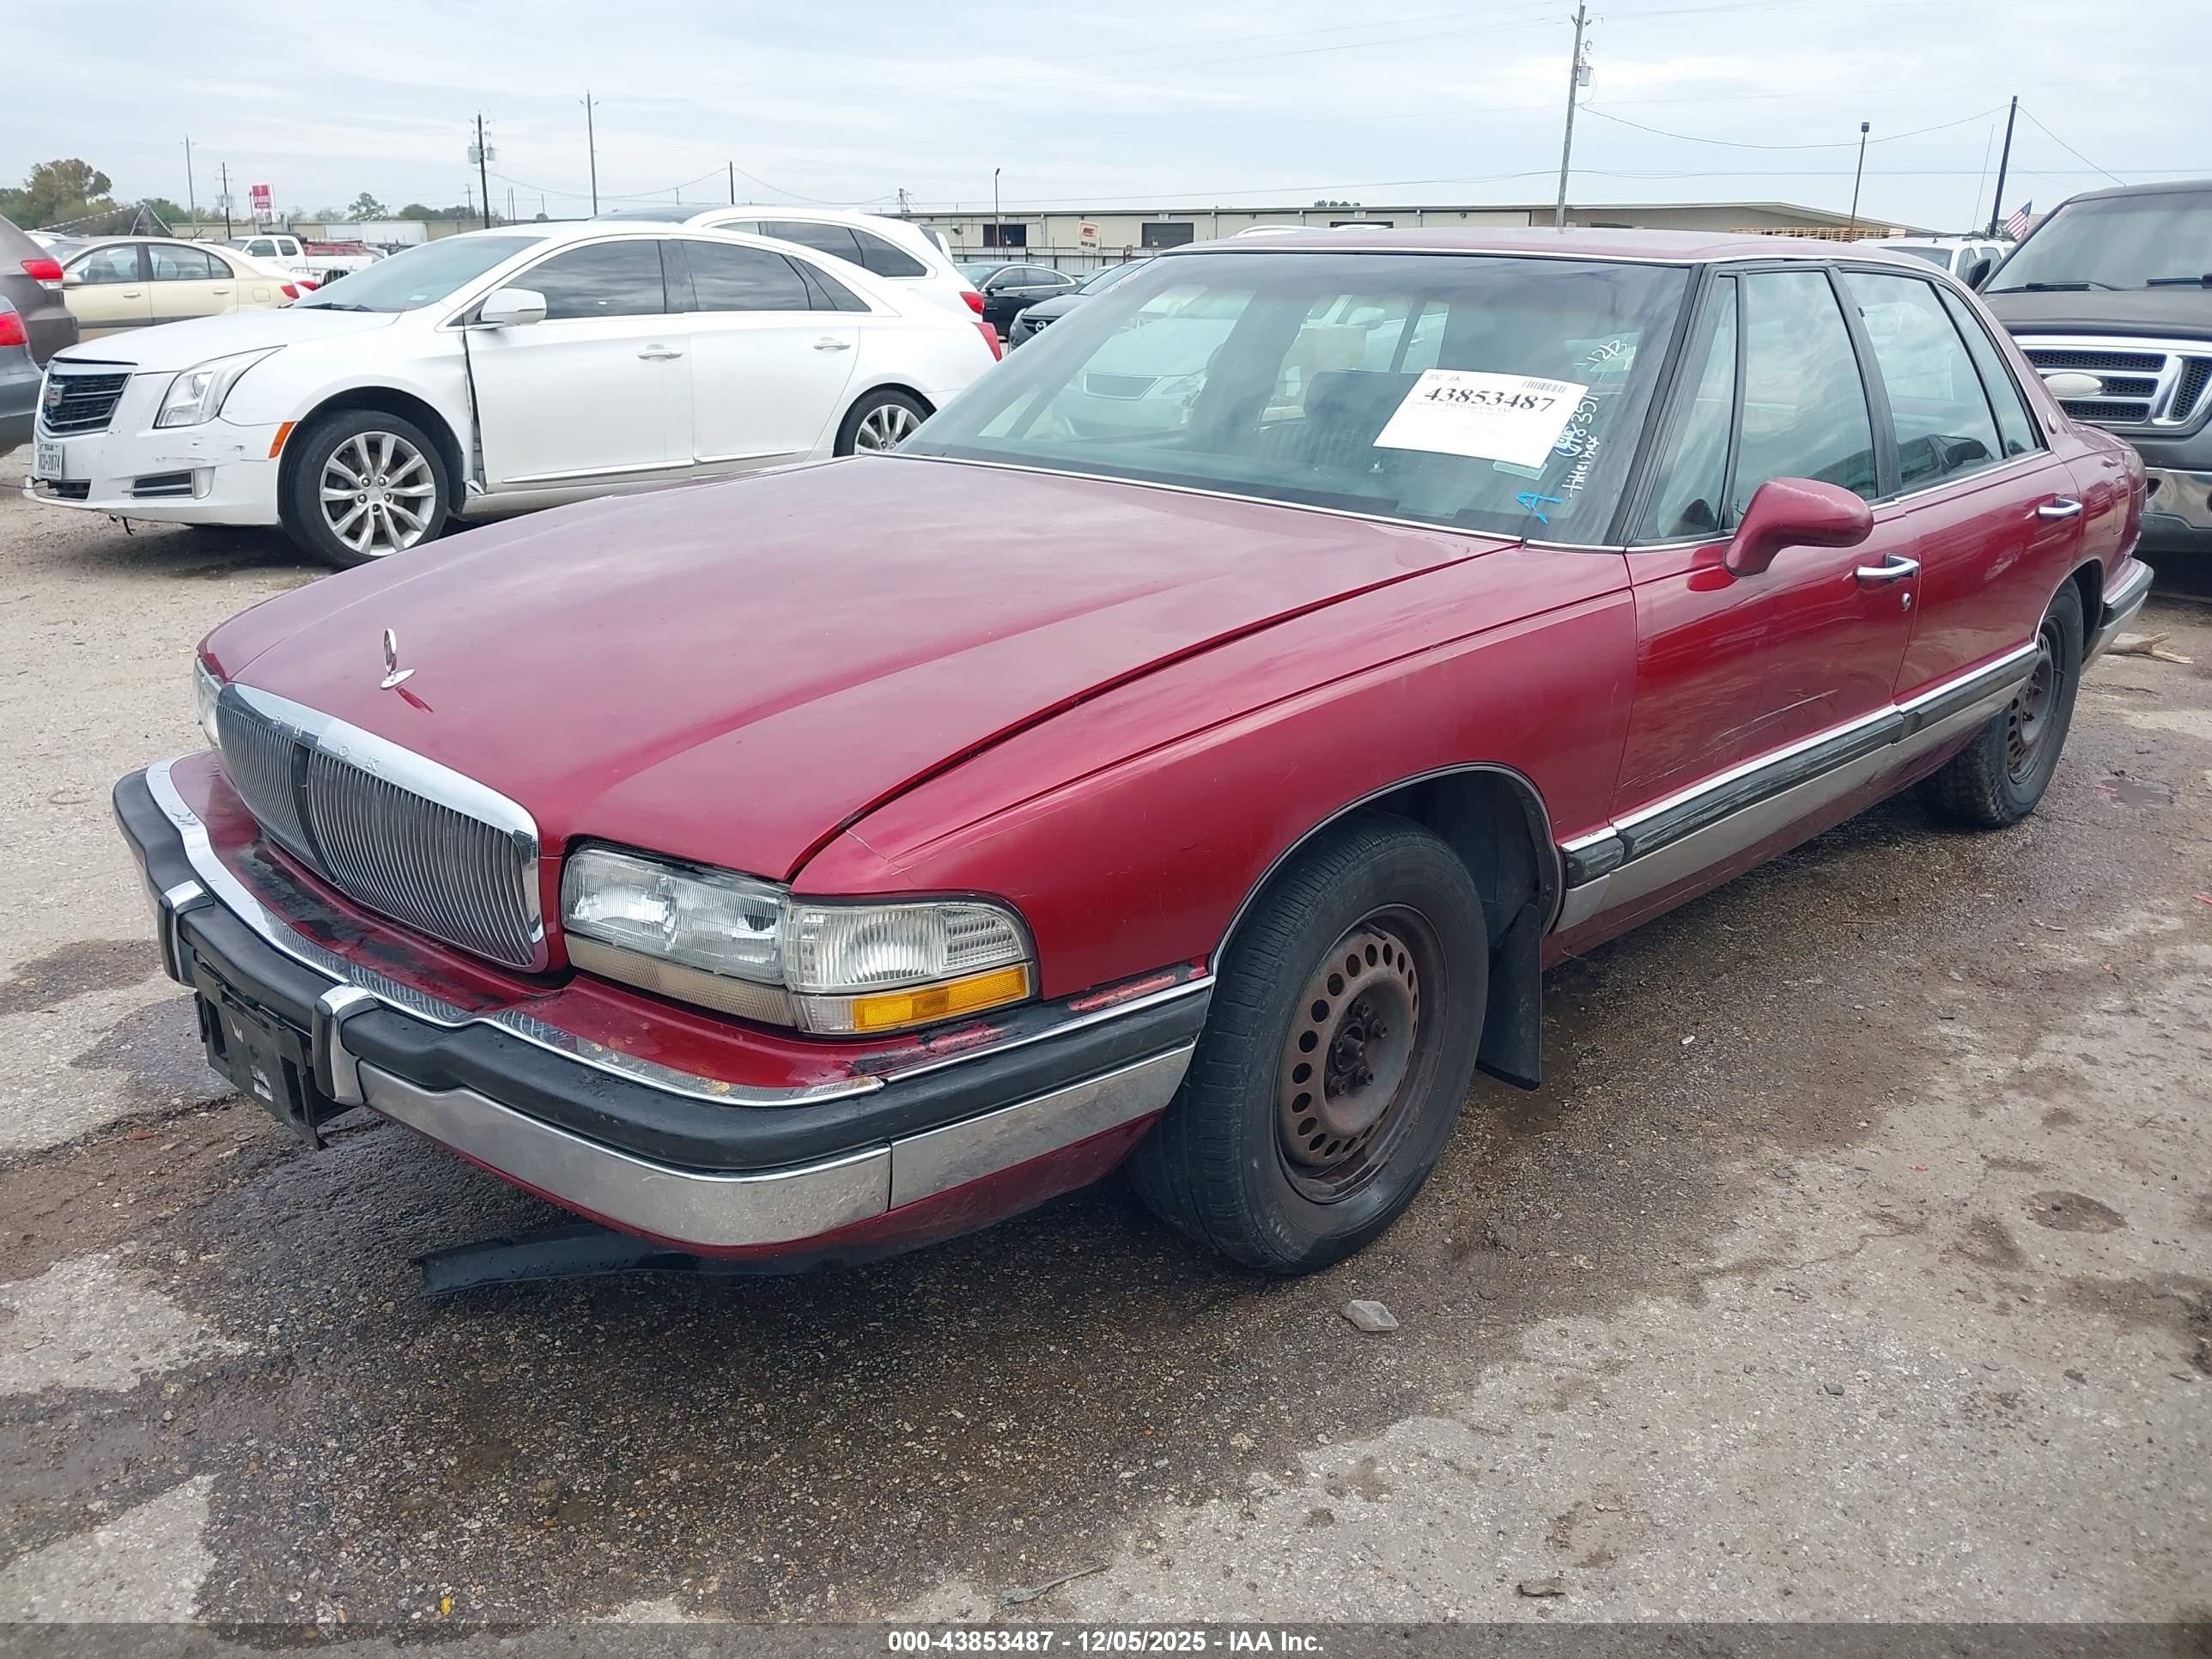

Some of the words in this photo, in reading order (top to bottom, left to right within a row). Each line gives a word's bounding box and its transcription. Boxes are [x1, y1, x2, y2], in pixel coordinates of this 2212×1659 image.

[1425, 387, 1556, 411] 43853487
[1516, 491, 1563, 524] A
[274, 714, 381, 772] BUICK
